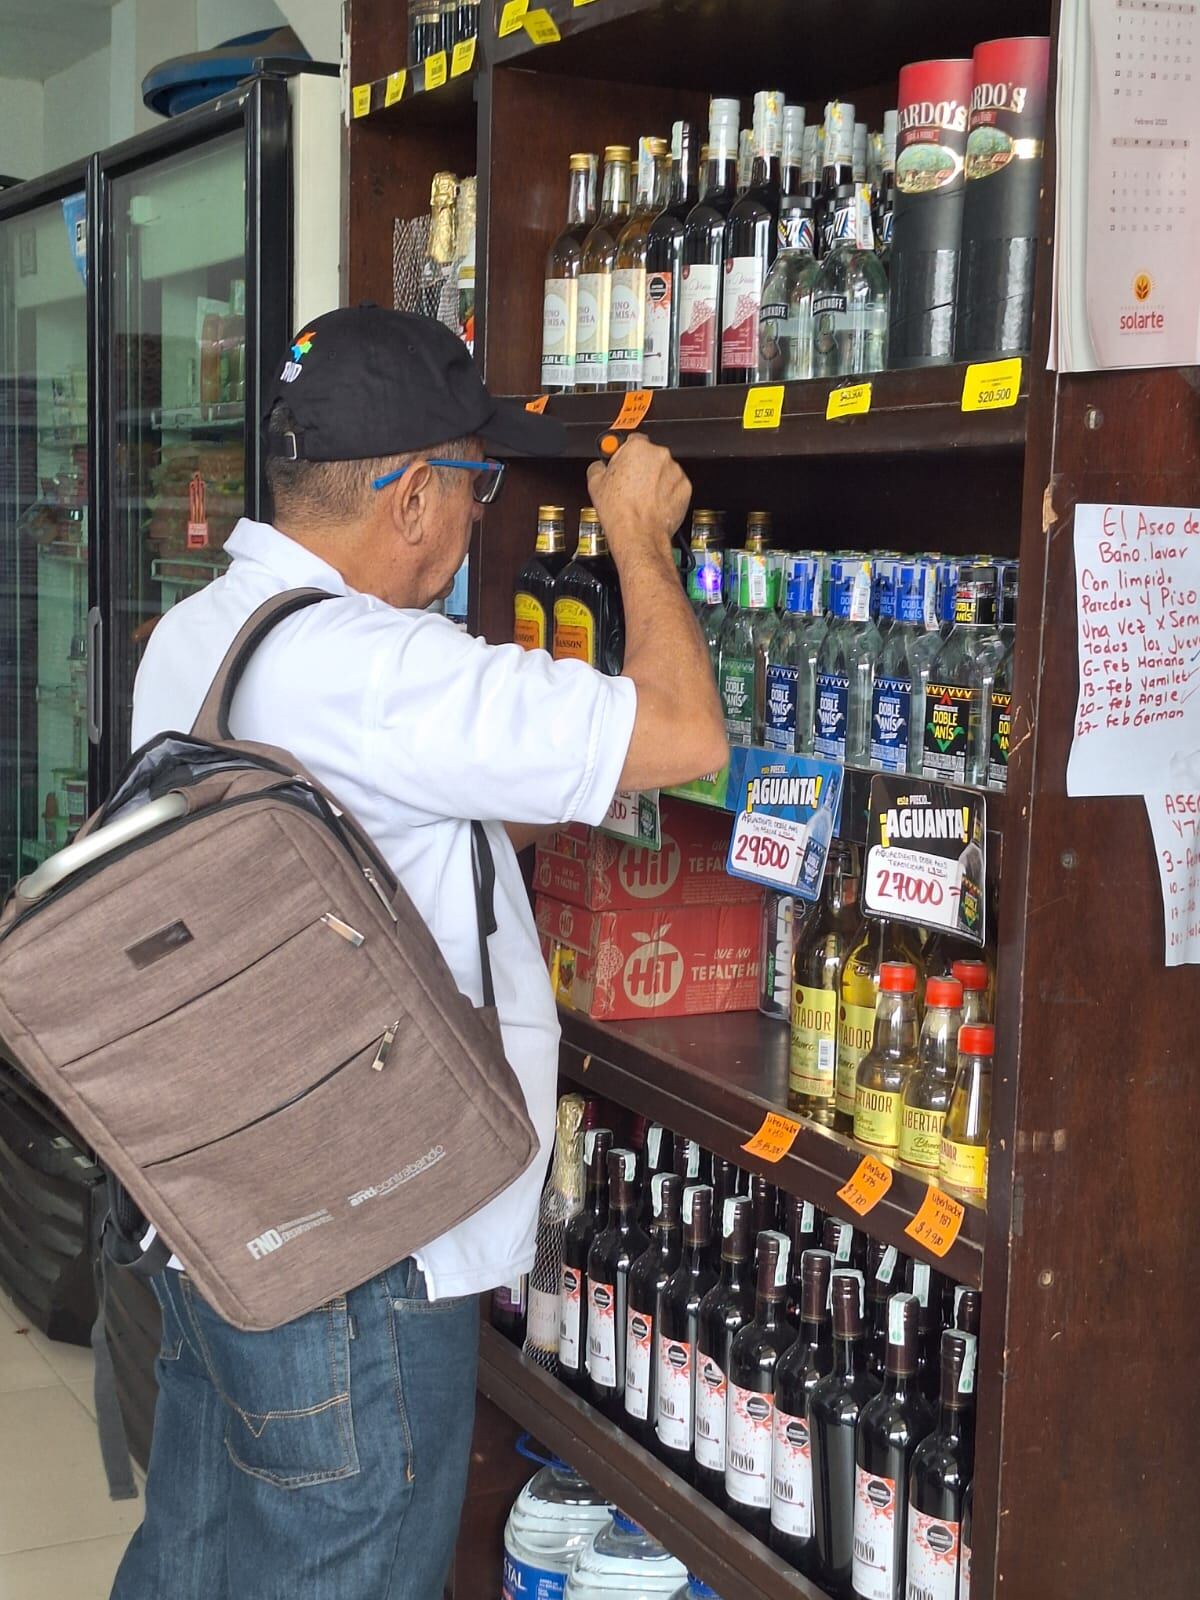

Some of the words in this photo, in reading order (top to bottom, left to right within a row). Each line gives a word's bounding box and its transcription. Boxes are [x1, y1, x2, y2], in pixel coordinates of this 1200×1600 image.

[1119, 311, 1164, 330] solarte
[1103, 507, 1127, 541] El
[1137, 511, 1176, 541] Aseo
[1081, 568, 1109, 592] Con
[933, 710, 959, 726] DOBLE
[746, 774, 823, 814] ¡AGUANTA!
[879, 806, 969, 849] ¡AGUANTA!
[246, 1228, 283, 1260] FND
